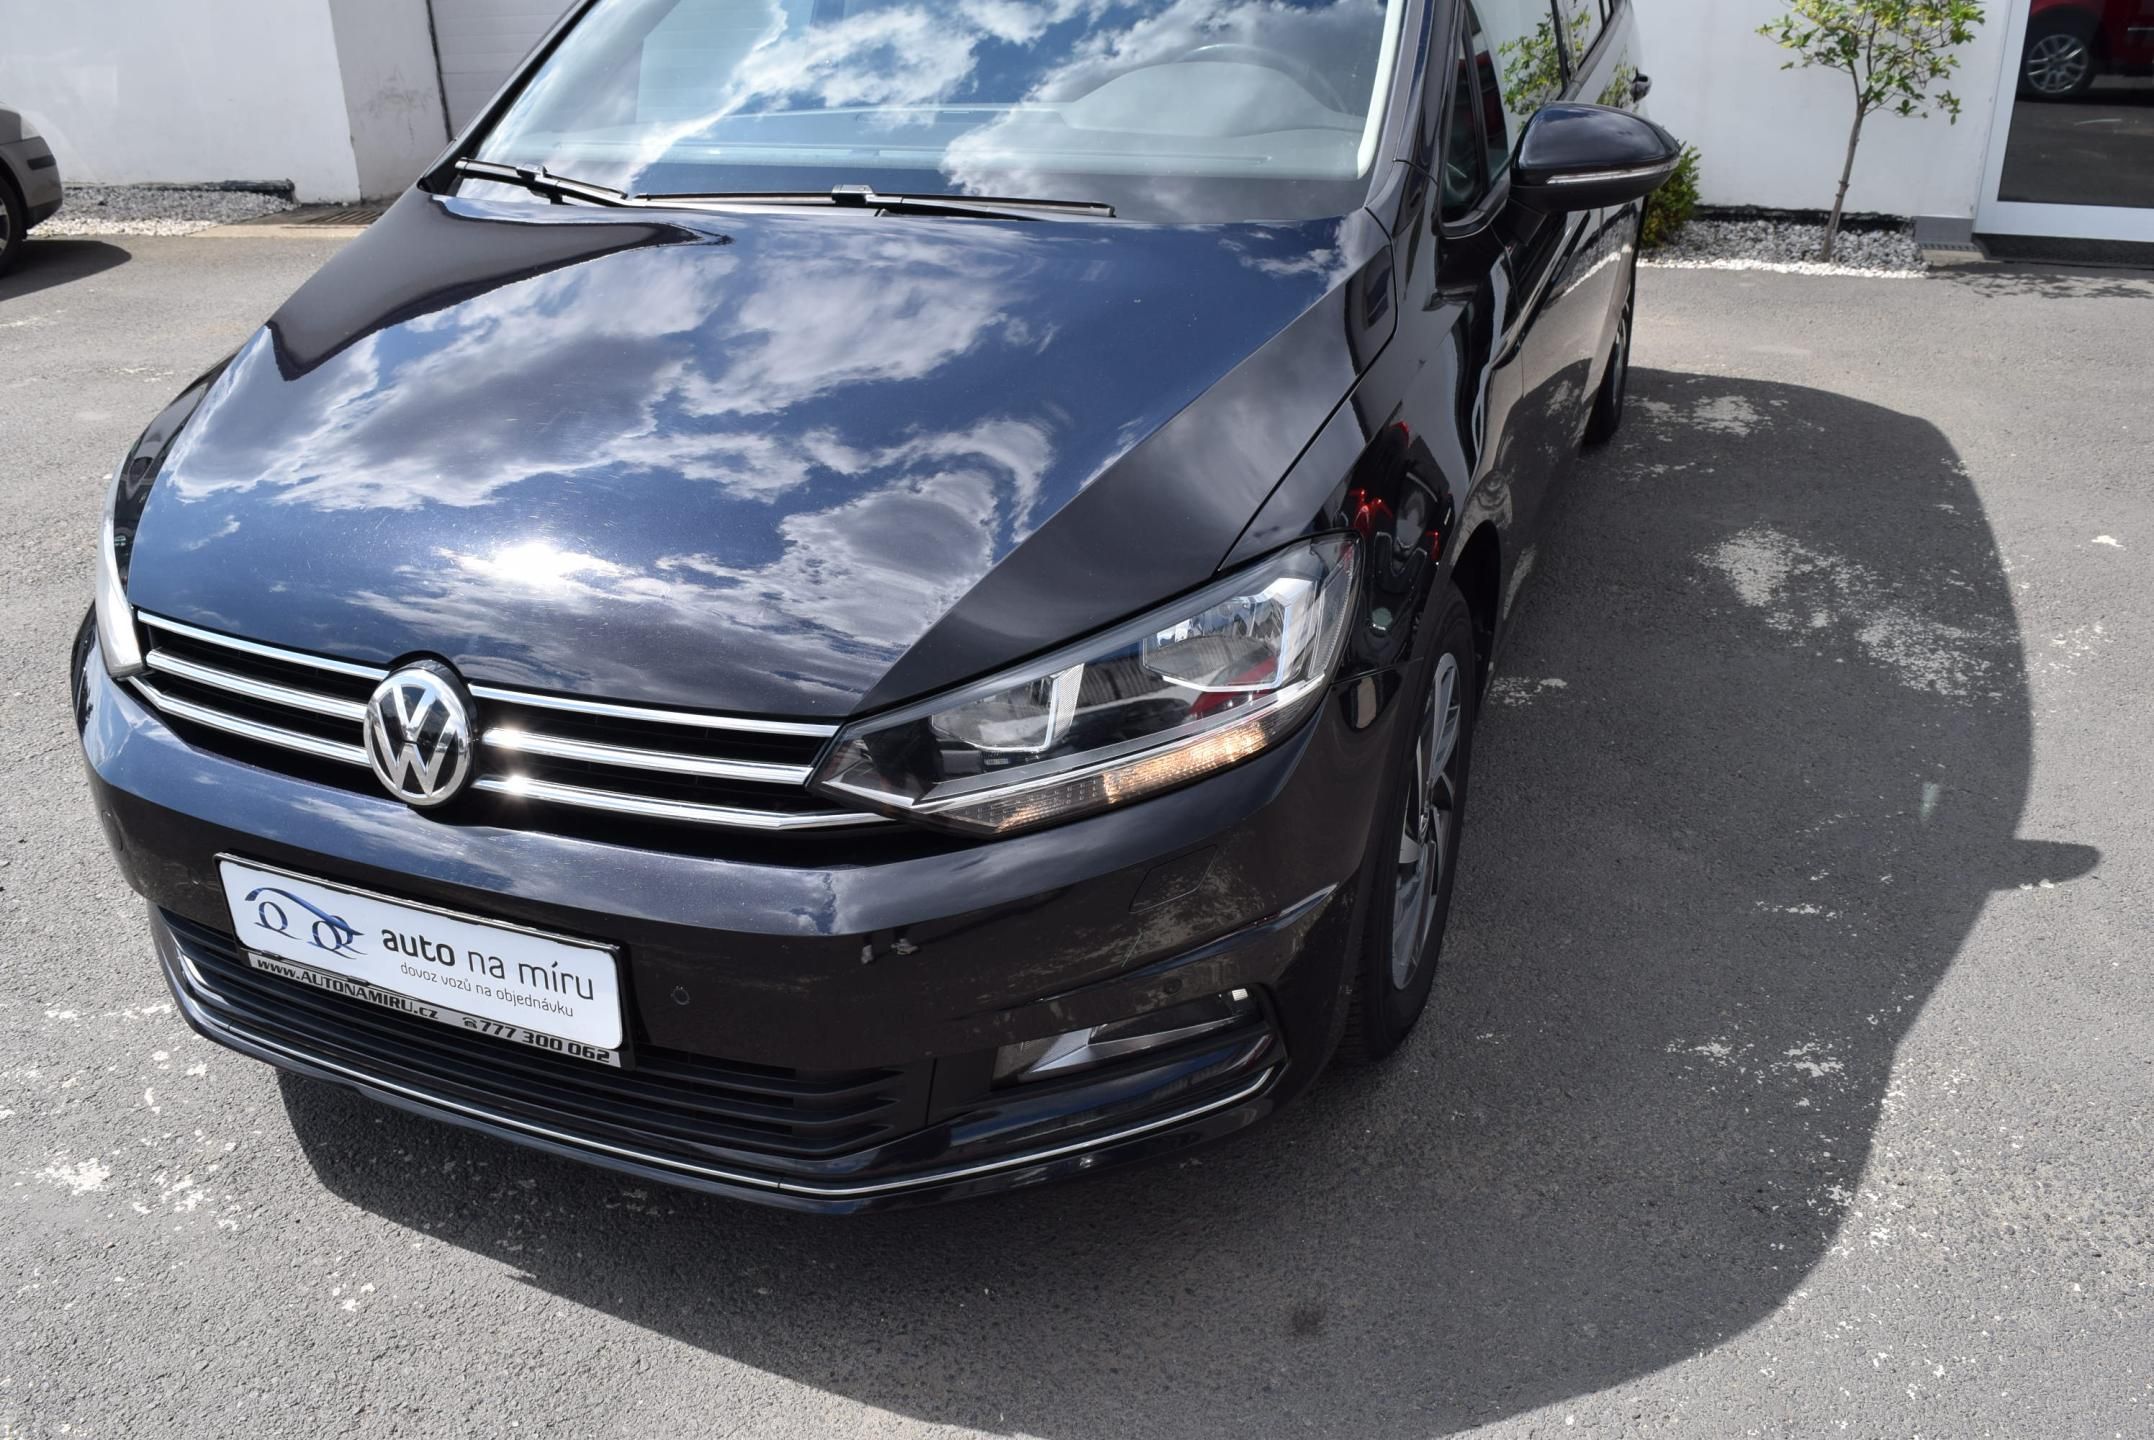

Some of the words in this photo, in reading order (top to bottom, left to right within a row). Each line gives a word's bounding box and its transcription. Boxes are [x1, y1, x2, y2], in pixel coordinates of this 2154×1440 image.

[381, 928, 456, 966] auto
[468, 950, 505, 979] na
[518, 960, 594, 1000] míru
[400, 962, 438, 983] dovoz
[441, 975, 472, 992] vozů
[476, 984, 492, 997] na
[496, 988, 574, 1017] objednávku
[257, 958, 439, 1019] www.AUTONAMIRU.cz
[479, 1020, 516, 1039] 777
[522, 1030, 563, 1051] 300
[568, 1042, 610, 1063] 062
